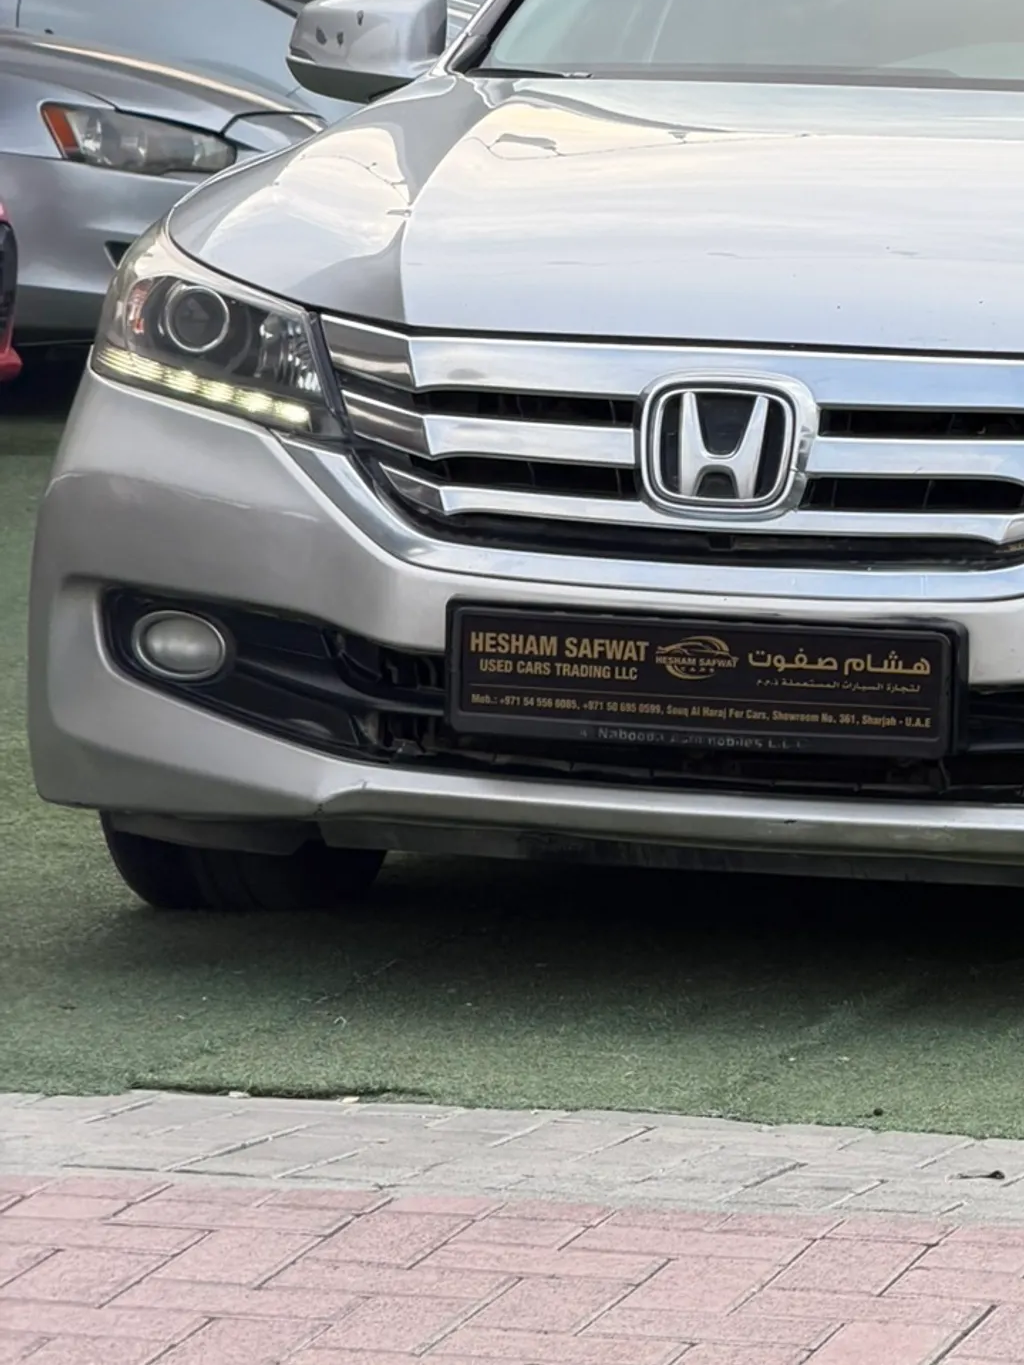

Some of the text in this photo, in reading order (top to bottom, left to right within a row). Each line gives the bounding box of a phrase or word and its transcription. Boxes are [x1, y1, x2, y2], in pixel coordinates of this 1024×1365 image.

[470, 631, 649, 662] HESHAM SAFWAT
[479, 659, 638, 680] USED CARS TRADING LLC
[748, 648, 931, 675] هشام صفوت
